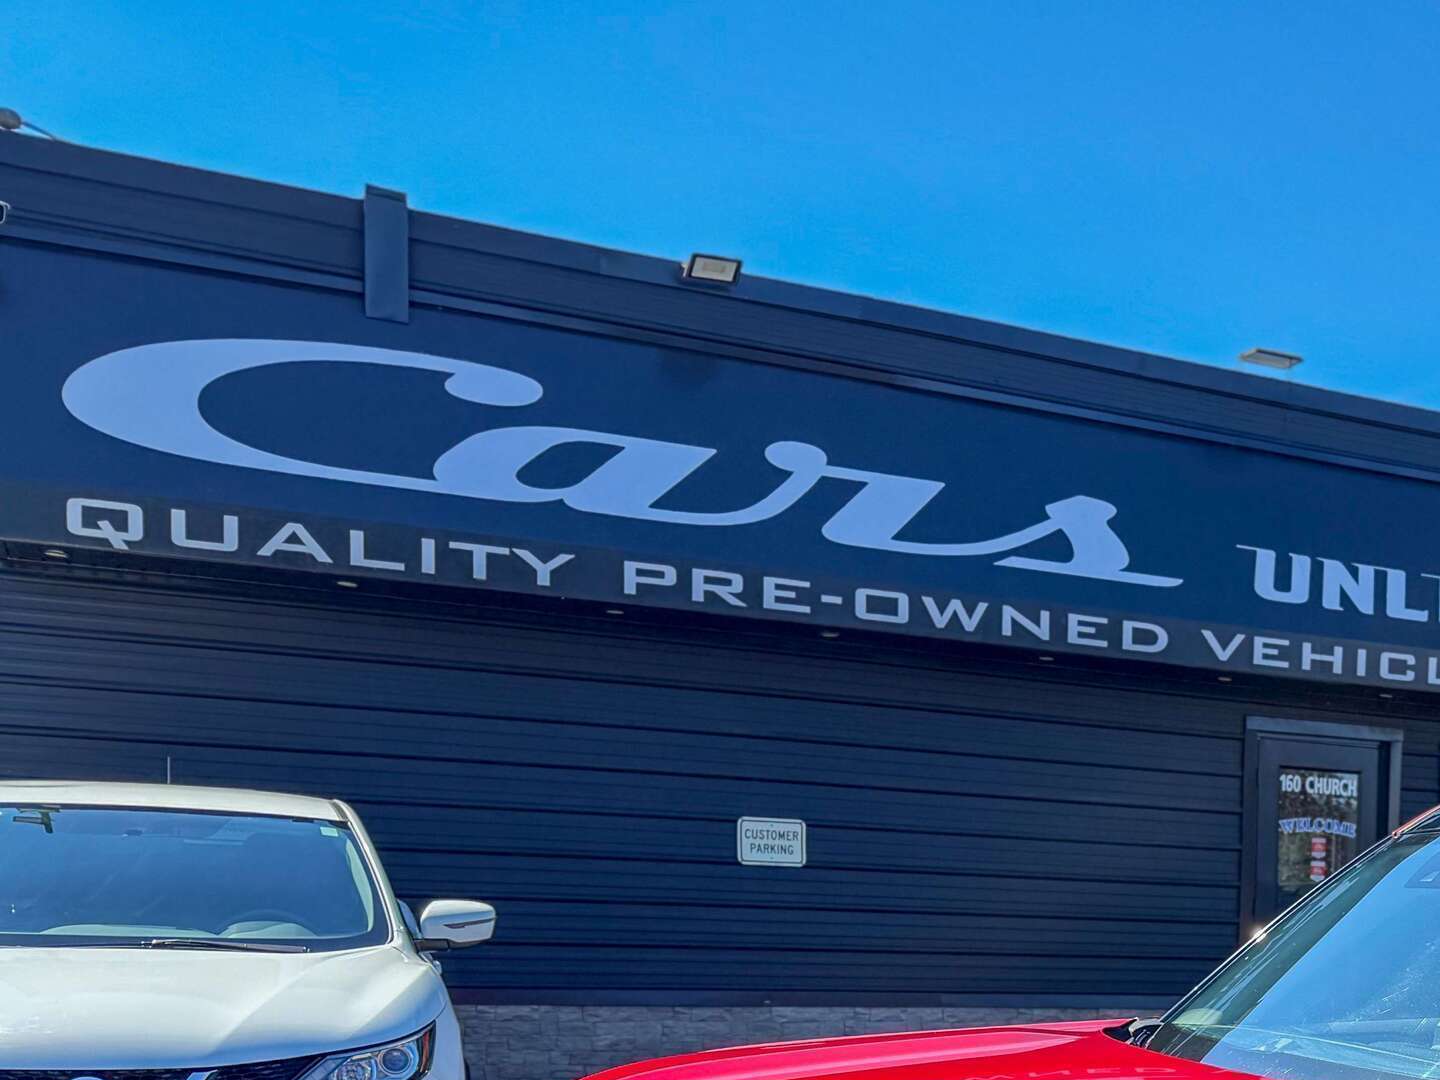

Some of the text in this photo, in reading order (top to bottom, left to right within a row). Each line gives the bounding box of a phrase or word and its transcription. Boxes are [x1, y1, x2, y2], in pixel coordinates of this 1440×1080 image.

[62, 338, 1183, 587] Cars
[66, 498, 575, 587] QUALITY
[623, 560, 1169, 653] PRE-OWNED
[1280, 774, 1358, 797] 160 CHURCH
[744, 828, 800, 841] CUSTOMER
[1279, 817, 1357, 839] WELCOME
[750, 843, 795, 856] PARKING
